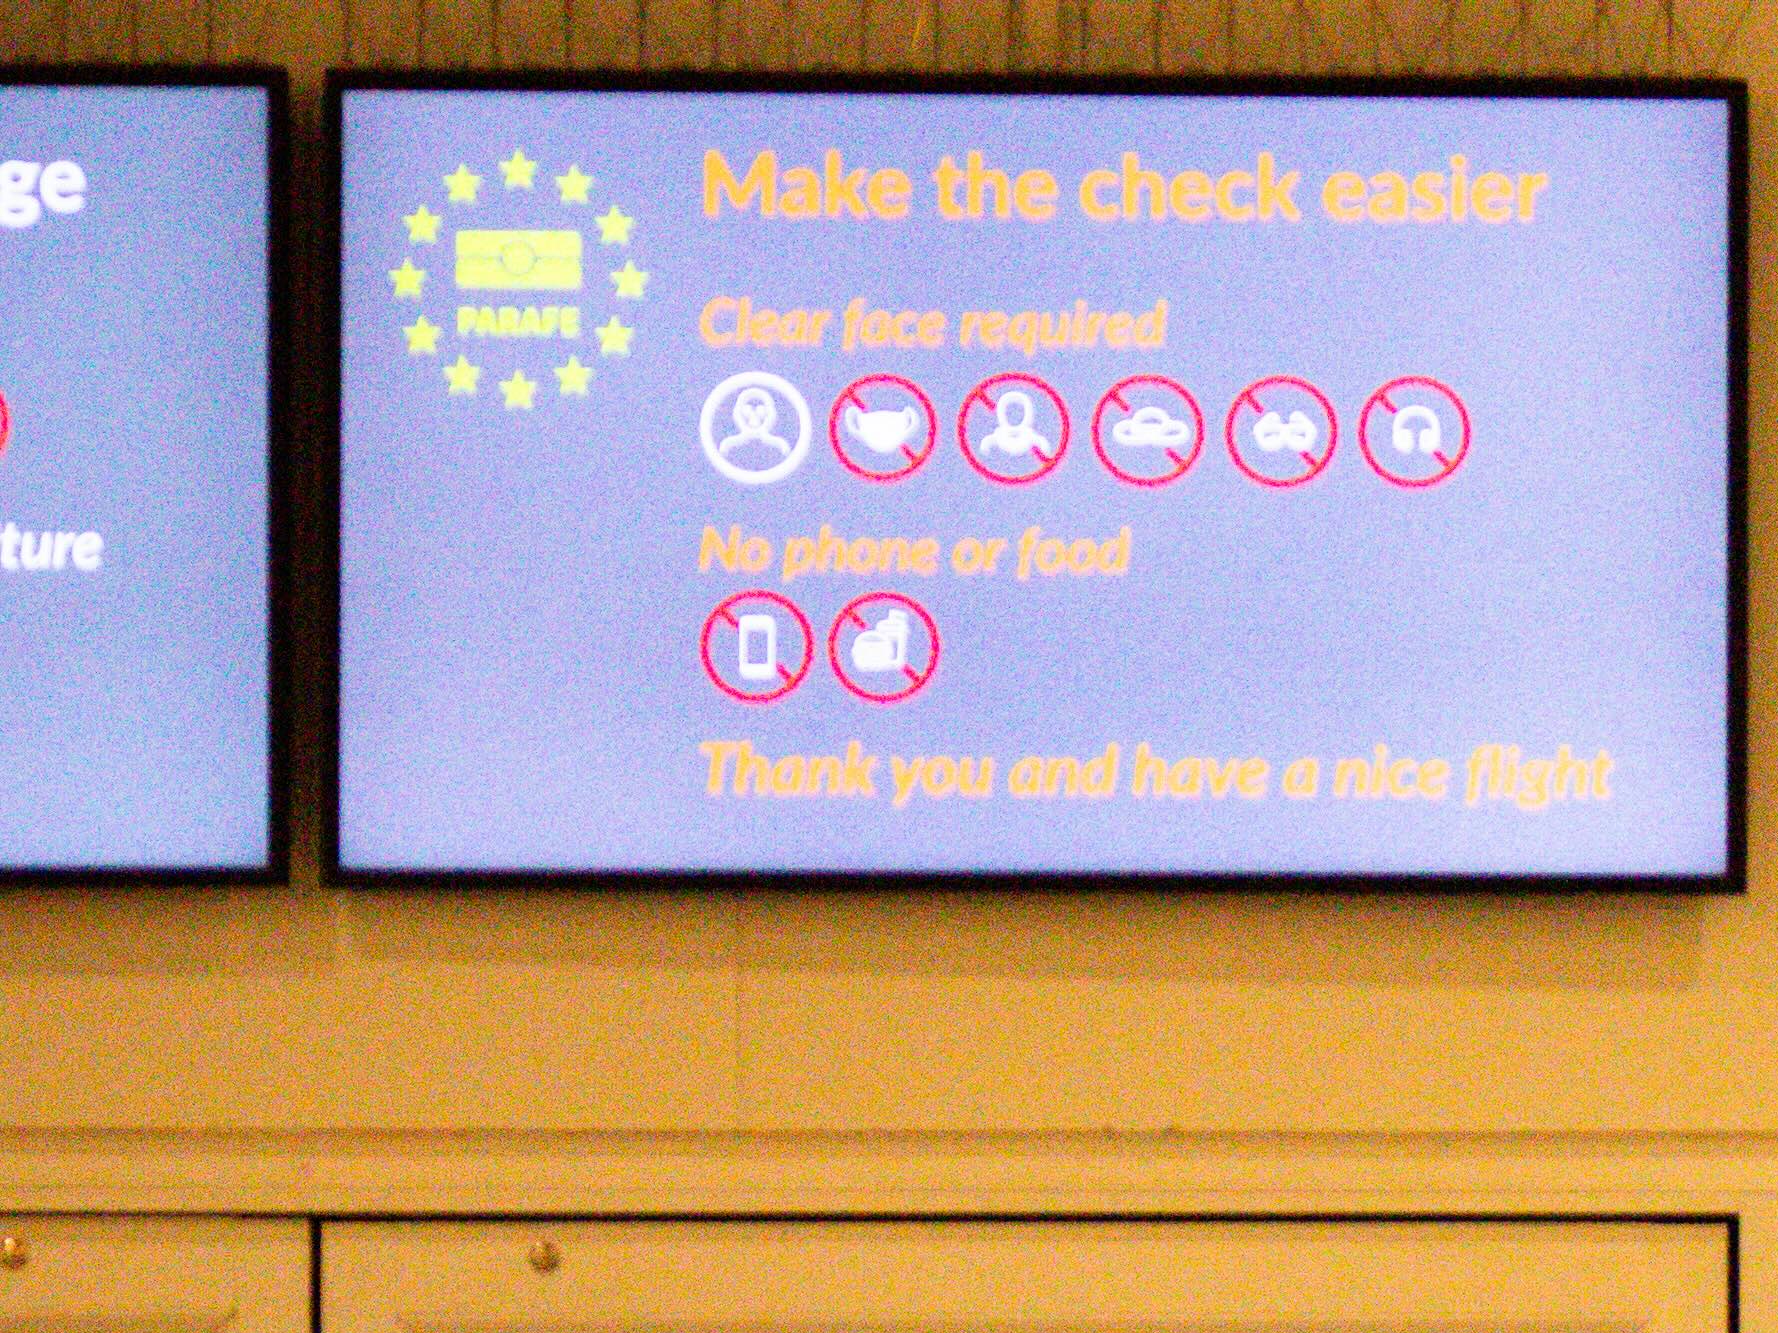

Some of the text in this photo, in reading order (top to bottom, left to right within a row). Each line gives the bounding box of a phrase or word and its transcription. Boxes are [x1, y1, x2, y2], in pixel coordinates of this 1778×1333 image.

[701, 148, 1547, 221] Make the check easier
[453, 304, 581, 338] PARAFE
[697, 295, 1168, 356] Clear face required
[695, 524, 1131, 580] No phone or food
[699, 738, 1613, 808] Thank you and have a nice flight
